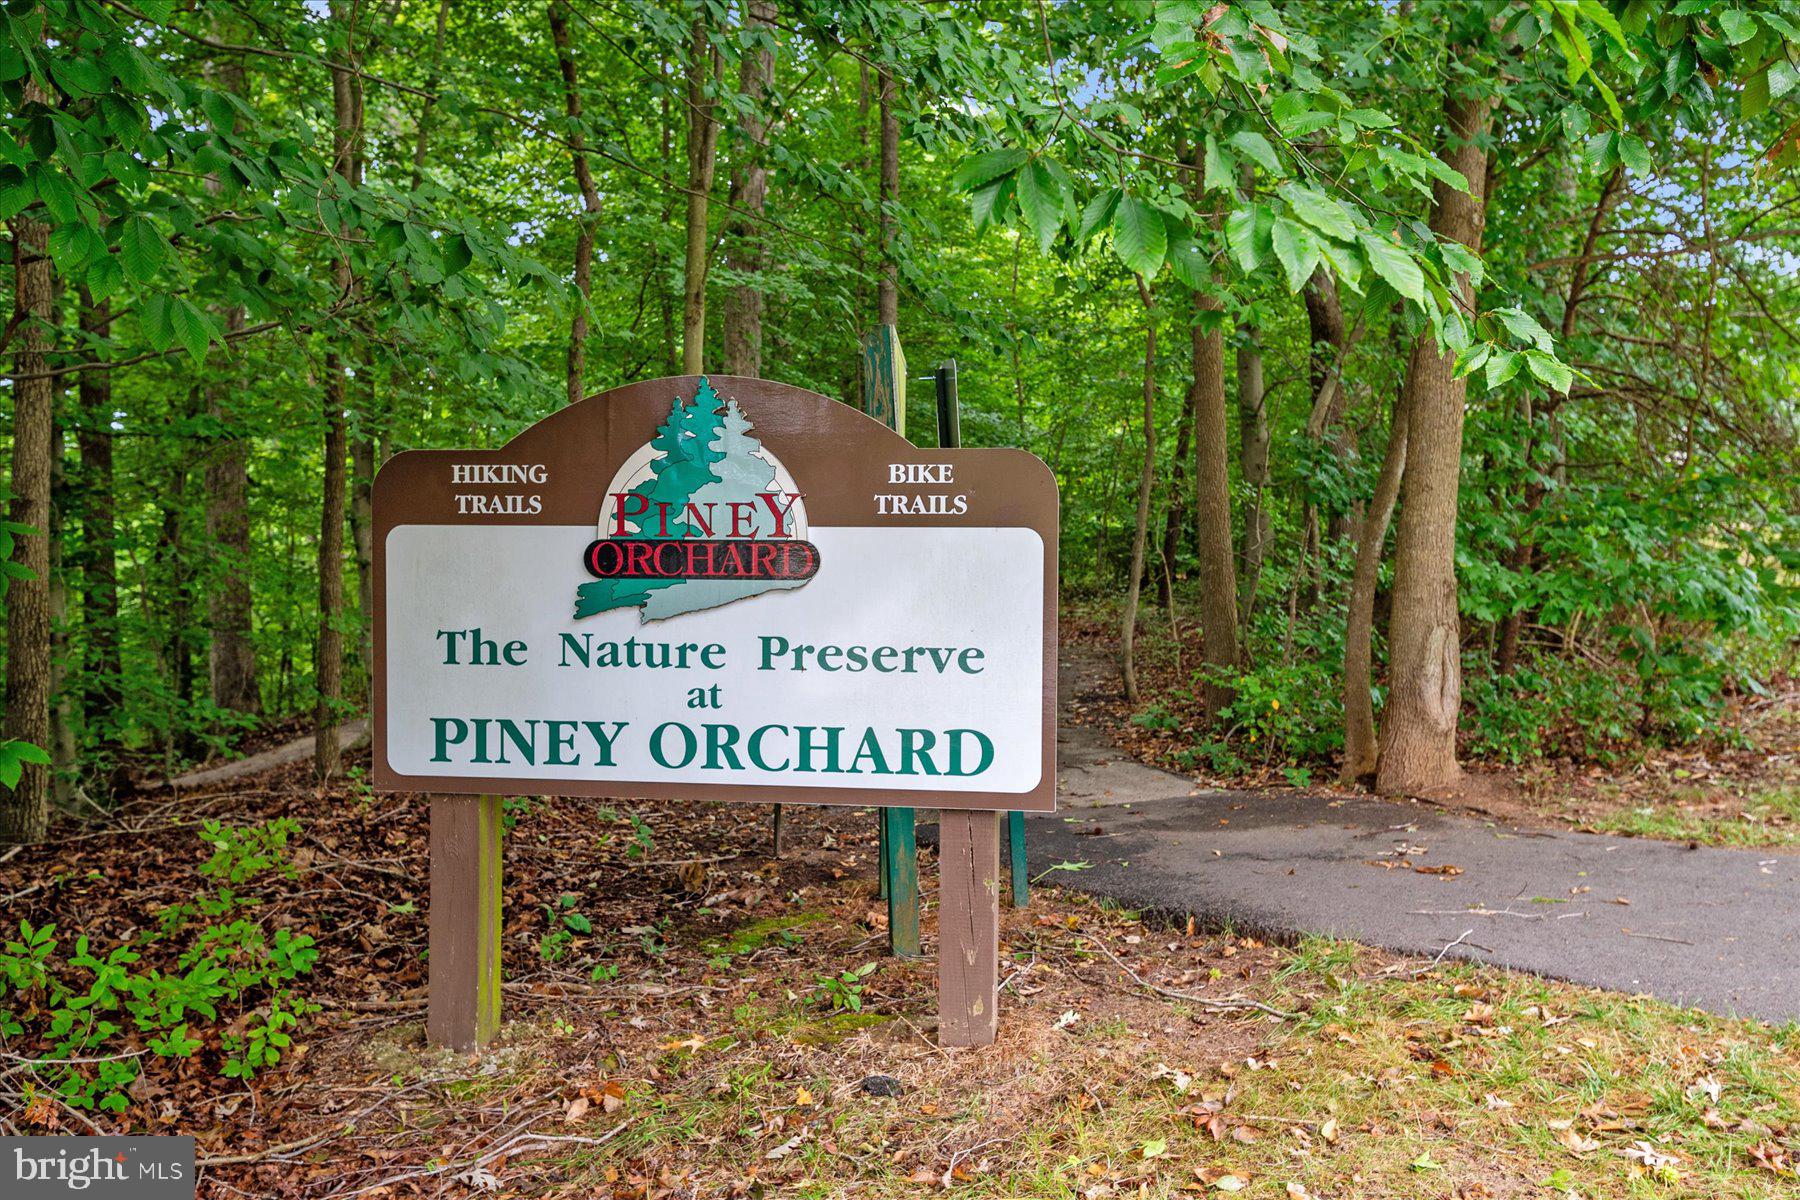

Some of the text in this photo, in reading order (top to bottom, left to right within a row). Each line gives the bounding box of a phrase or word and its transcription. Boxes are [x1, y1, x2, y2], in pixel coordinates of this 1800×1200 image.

[451, 463, 549, 485] HIKING
[888, 463, 954, 484] BIKE
[455, 494, 543, 515] TRAILS
[608, 492, 806, 539] PINEY
[874, 494, 968, 515] TRAILS
[591, 542, 815, 579] ORCHARD
[436, 628, 986, 675] The Nature Preserve
[686, 681, 723, 710] at
[429, 717, 995, 777] PINEY ORCHARD
